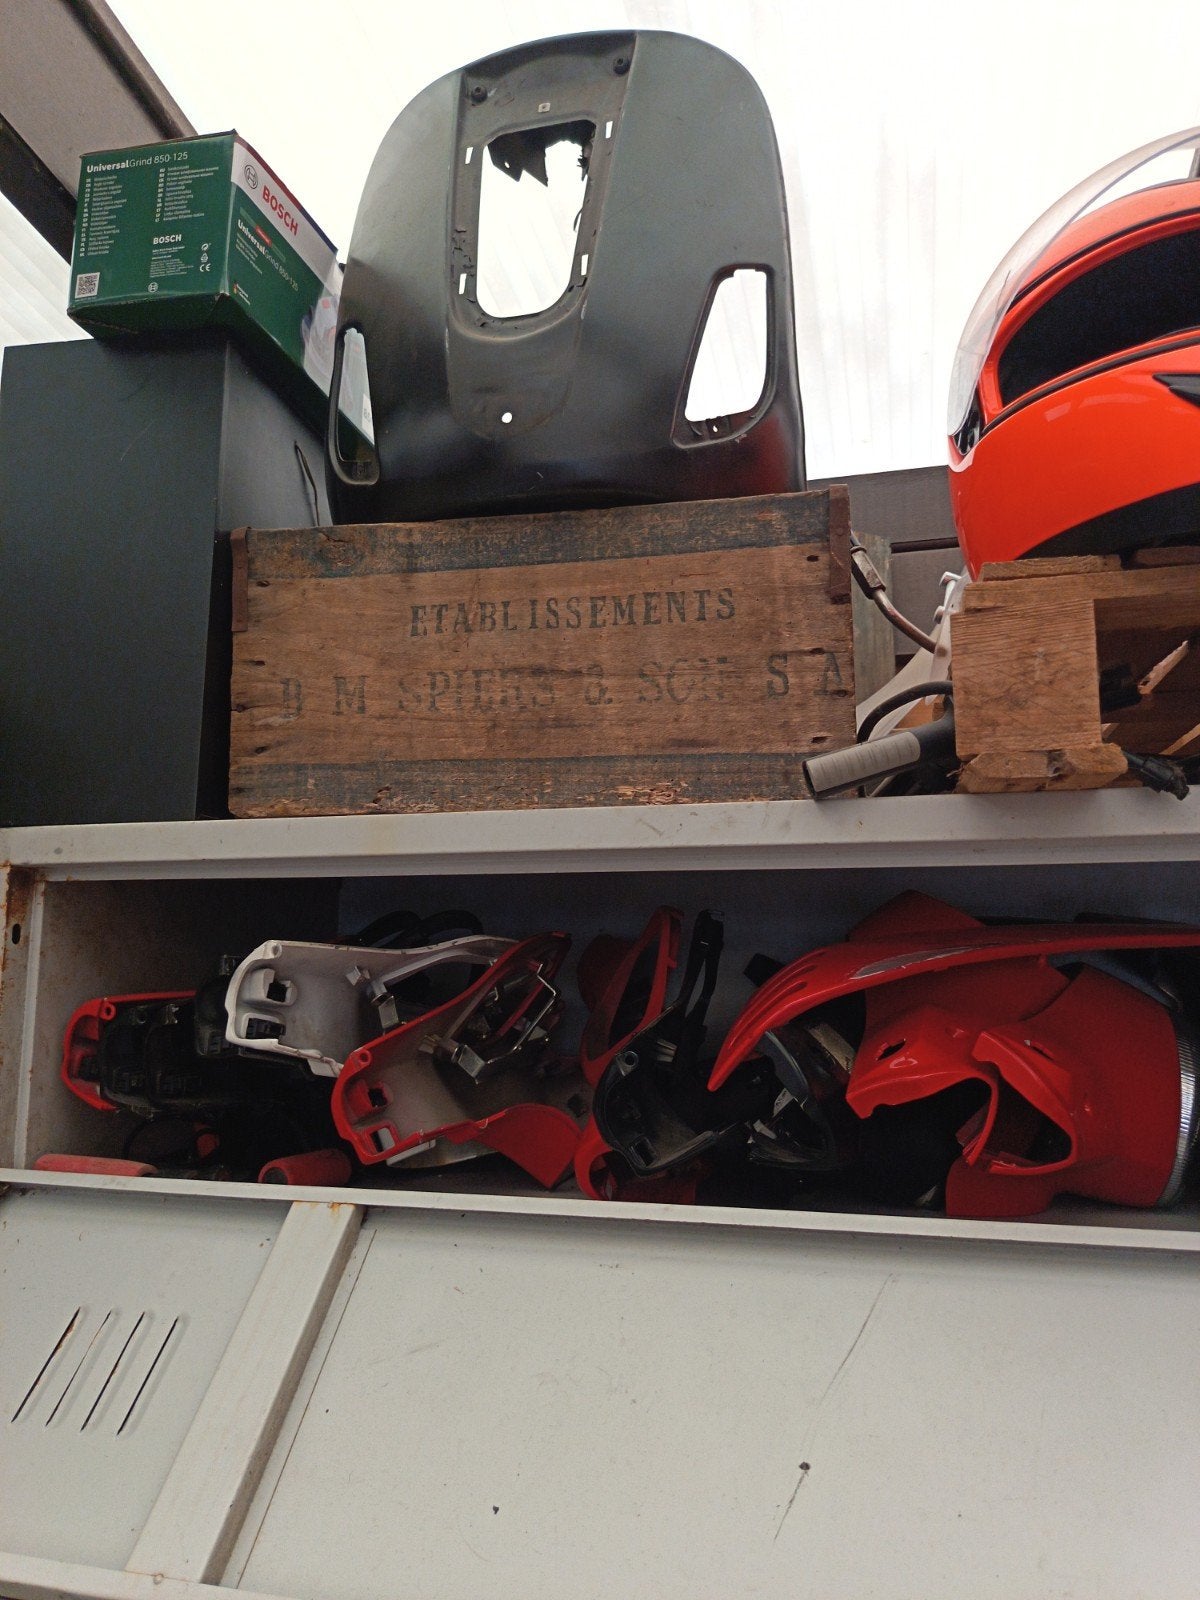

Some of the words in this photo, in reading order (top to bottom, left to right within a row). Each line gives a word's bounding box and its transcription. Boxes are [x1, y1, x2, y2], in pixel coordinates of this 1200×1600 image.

[86, 158, 152, 174] UniversalGrind
[262, 185, 299, 236] BOSCH
[152, 233, 183, 245] BOSCH
[237, 218, 279, 270] UniversalGrind
[408, 587, 736, 637] ETABLISSEMENTS
[766, 652, 791, 701] S
